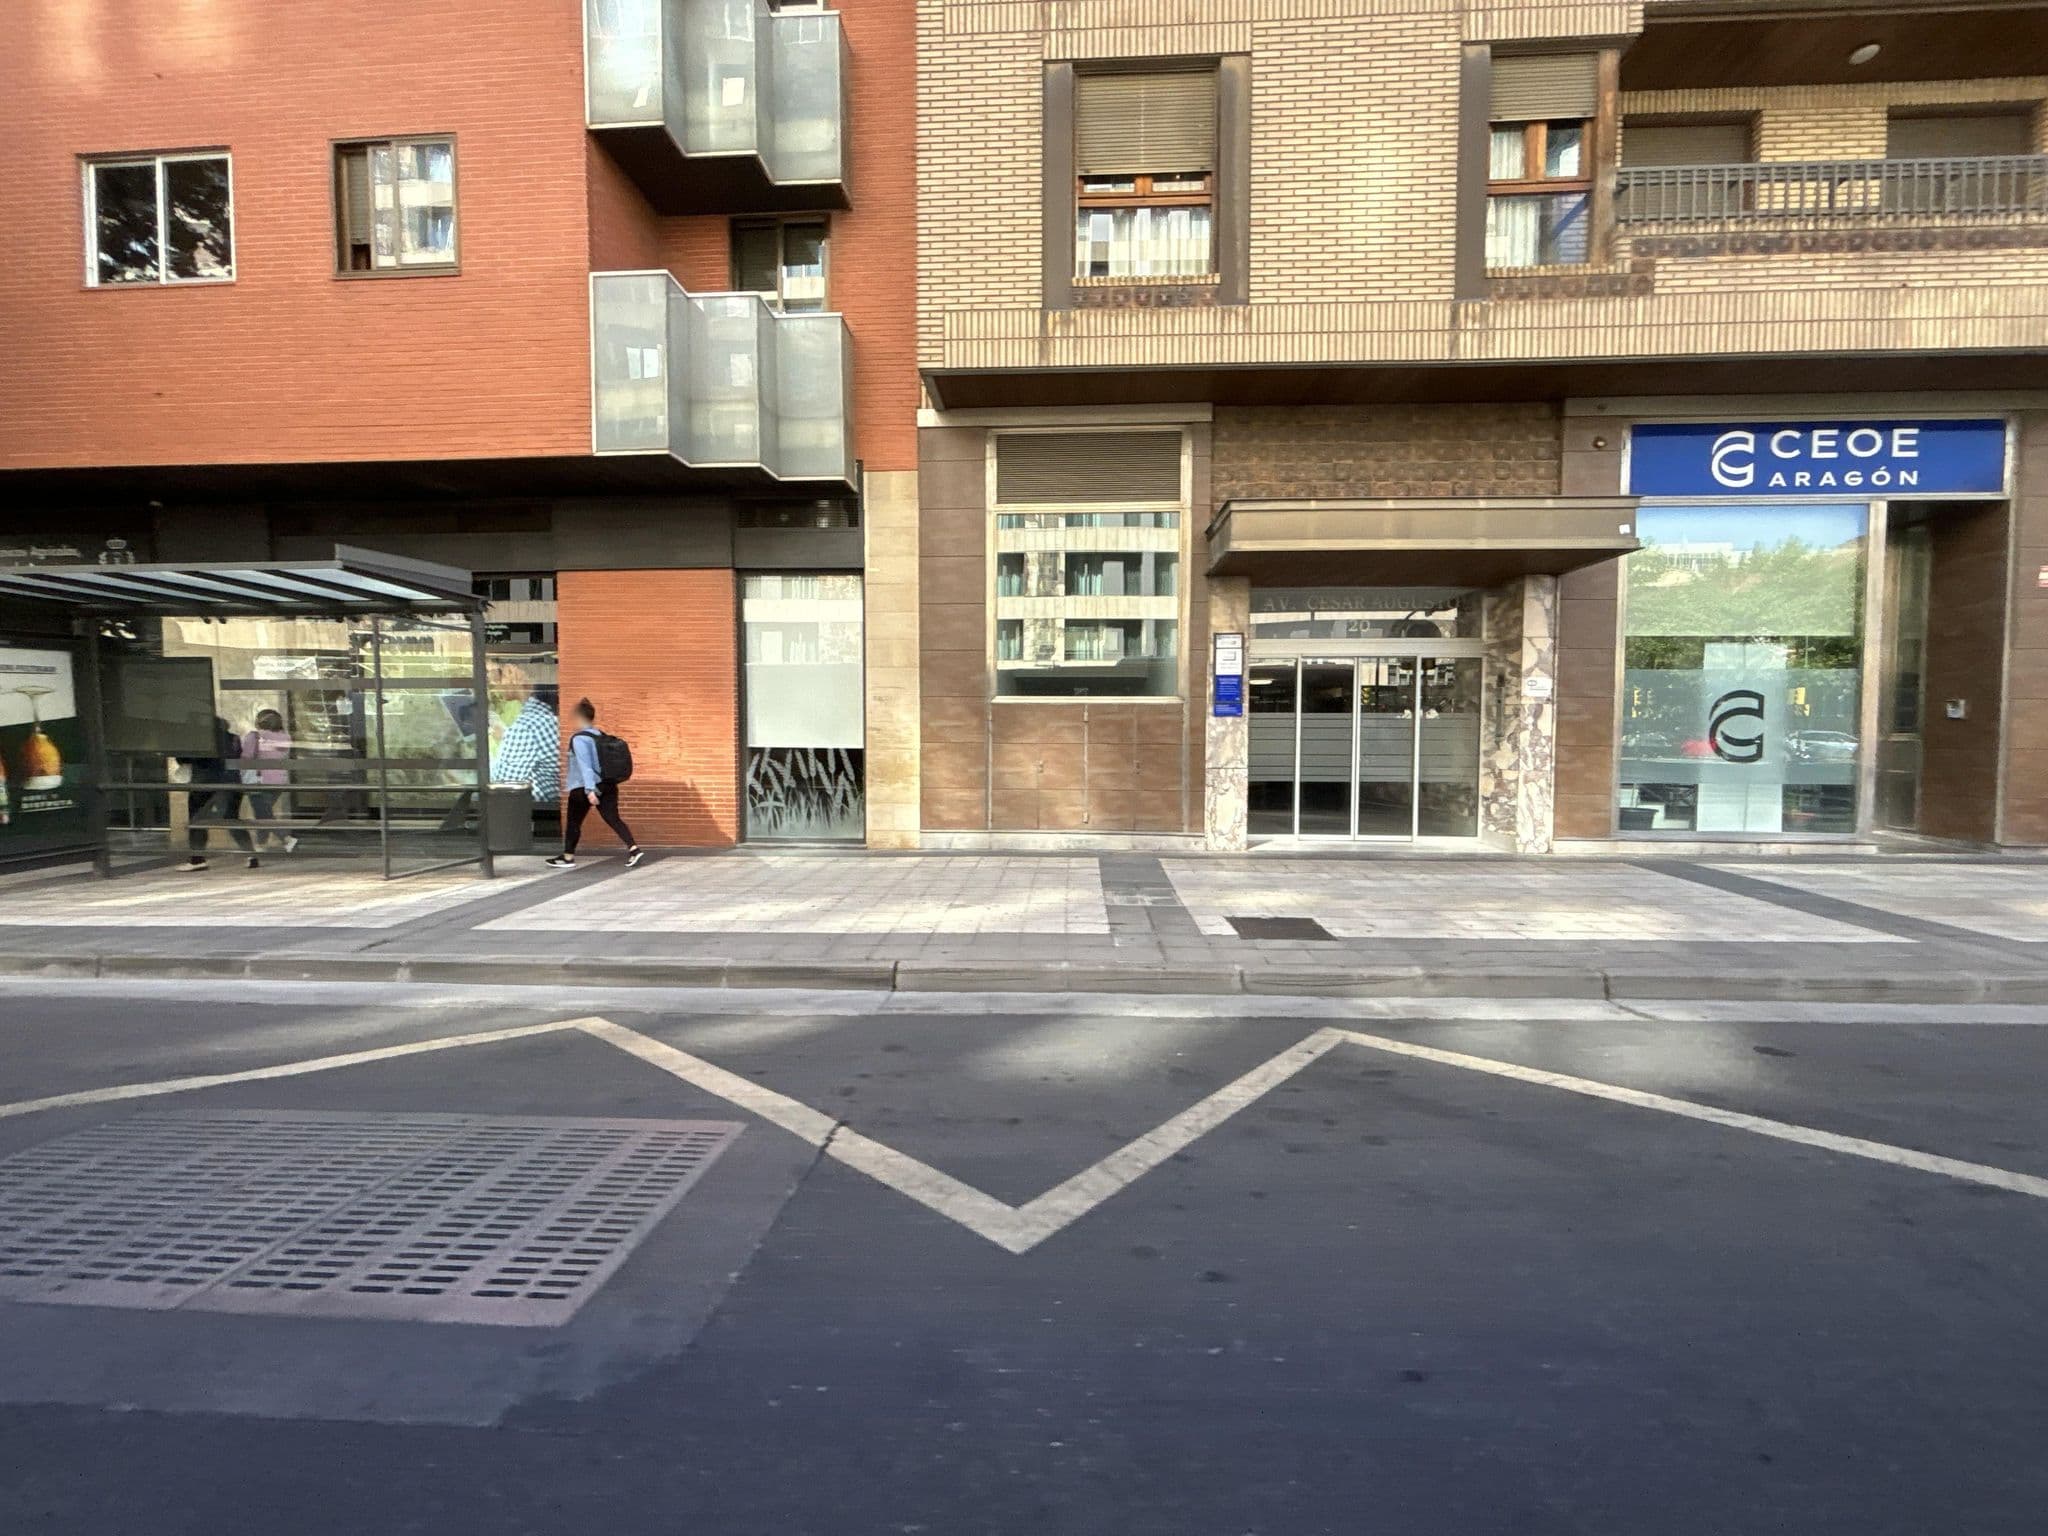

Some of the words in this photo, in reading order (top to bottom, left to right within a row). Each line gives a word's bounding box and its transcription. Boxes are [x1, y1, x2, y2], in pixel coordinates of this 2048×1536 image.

[1770, 428, 1920, 459] CEOE
[1768, 466, 1919, 487] ARAGÓN
[1263, 597, 1296, 611] AV.
[1348, 619, 1371, 632] 20
